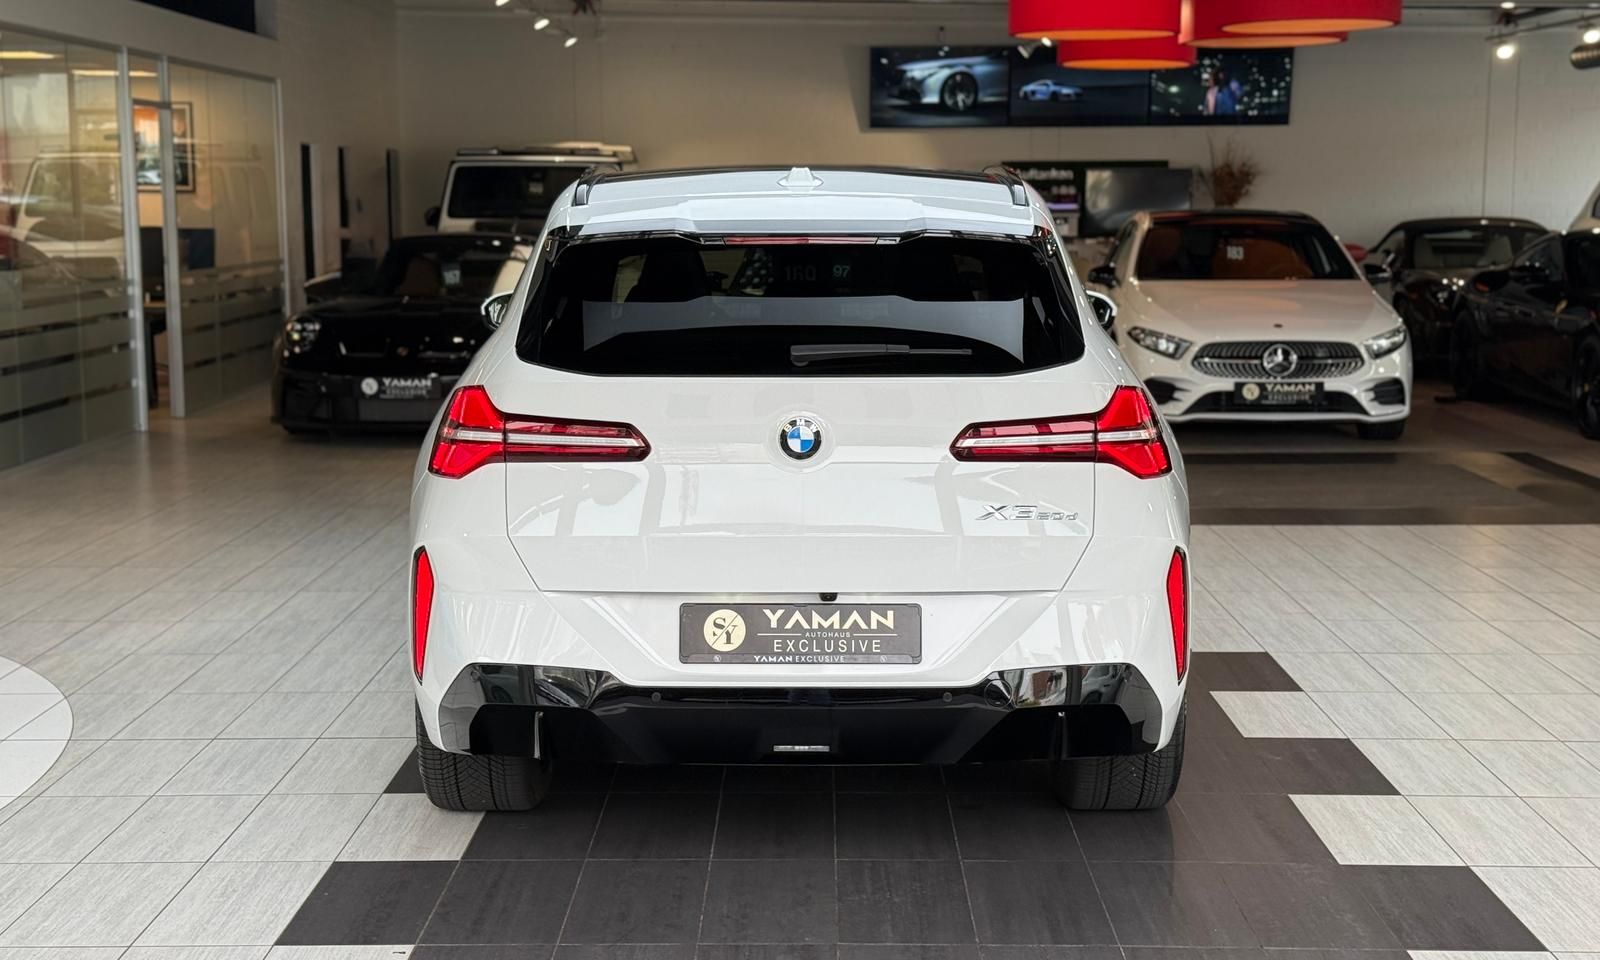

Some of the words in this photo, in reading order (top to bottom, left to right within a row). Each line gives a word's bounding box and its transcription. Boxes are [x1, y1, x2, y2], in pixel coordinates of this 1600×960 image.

[1265, 383, 1316, 392] YAMAN
[762, 609, 895, 630] YAMAN
[773, 639, 881, 653] EXCLUSIVE
[753, 655, 793, 663] YAMAN
[795, 655, 846, 663] EXCLUSIVE
